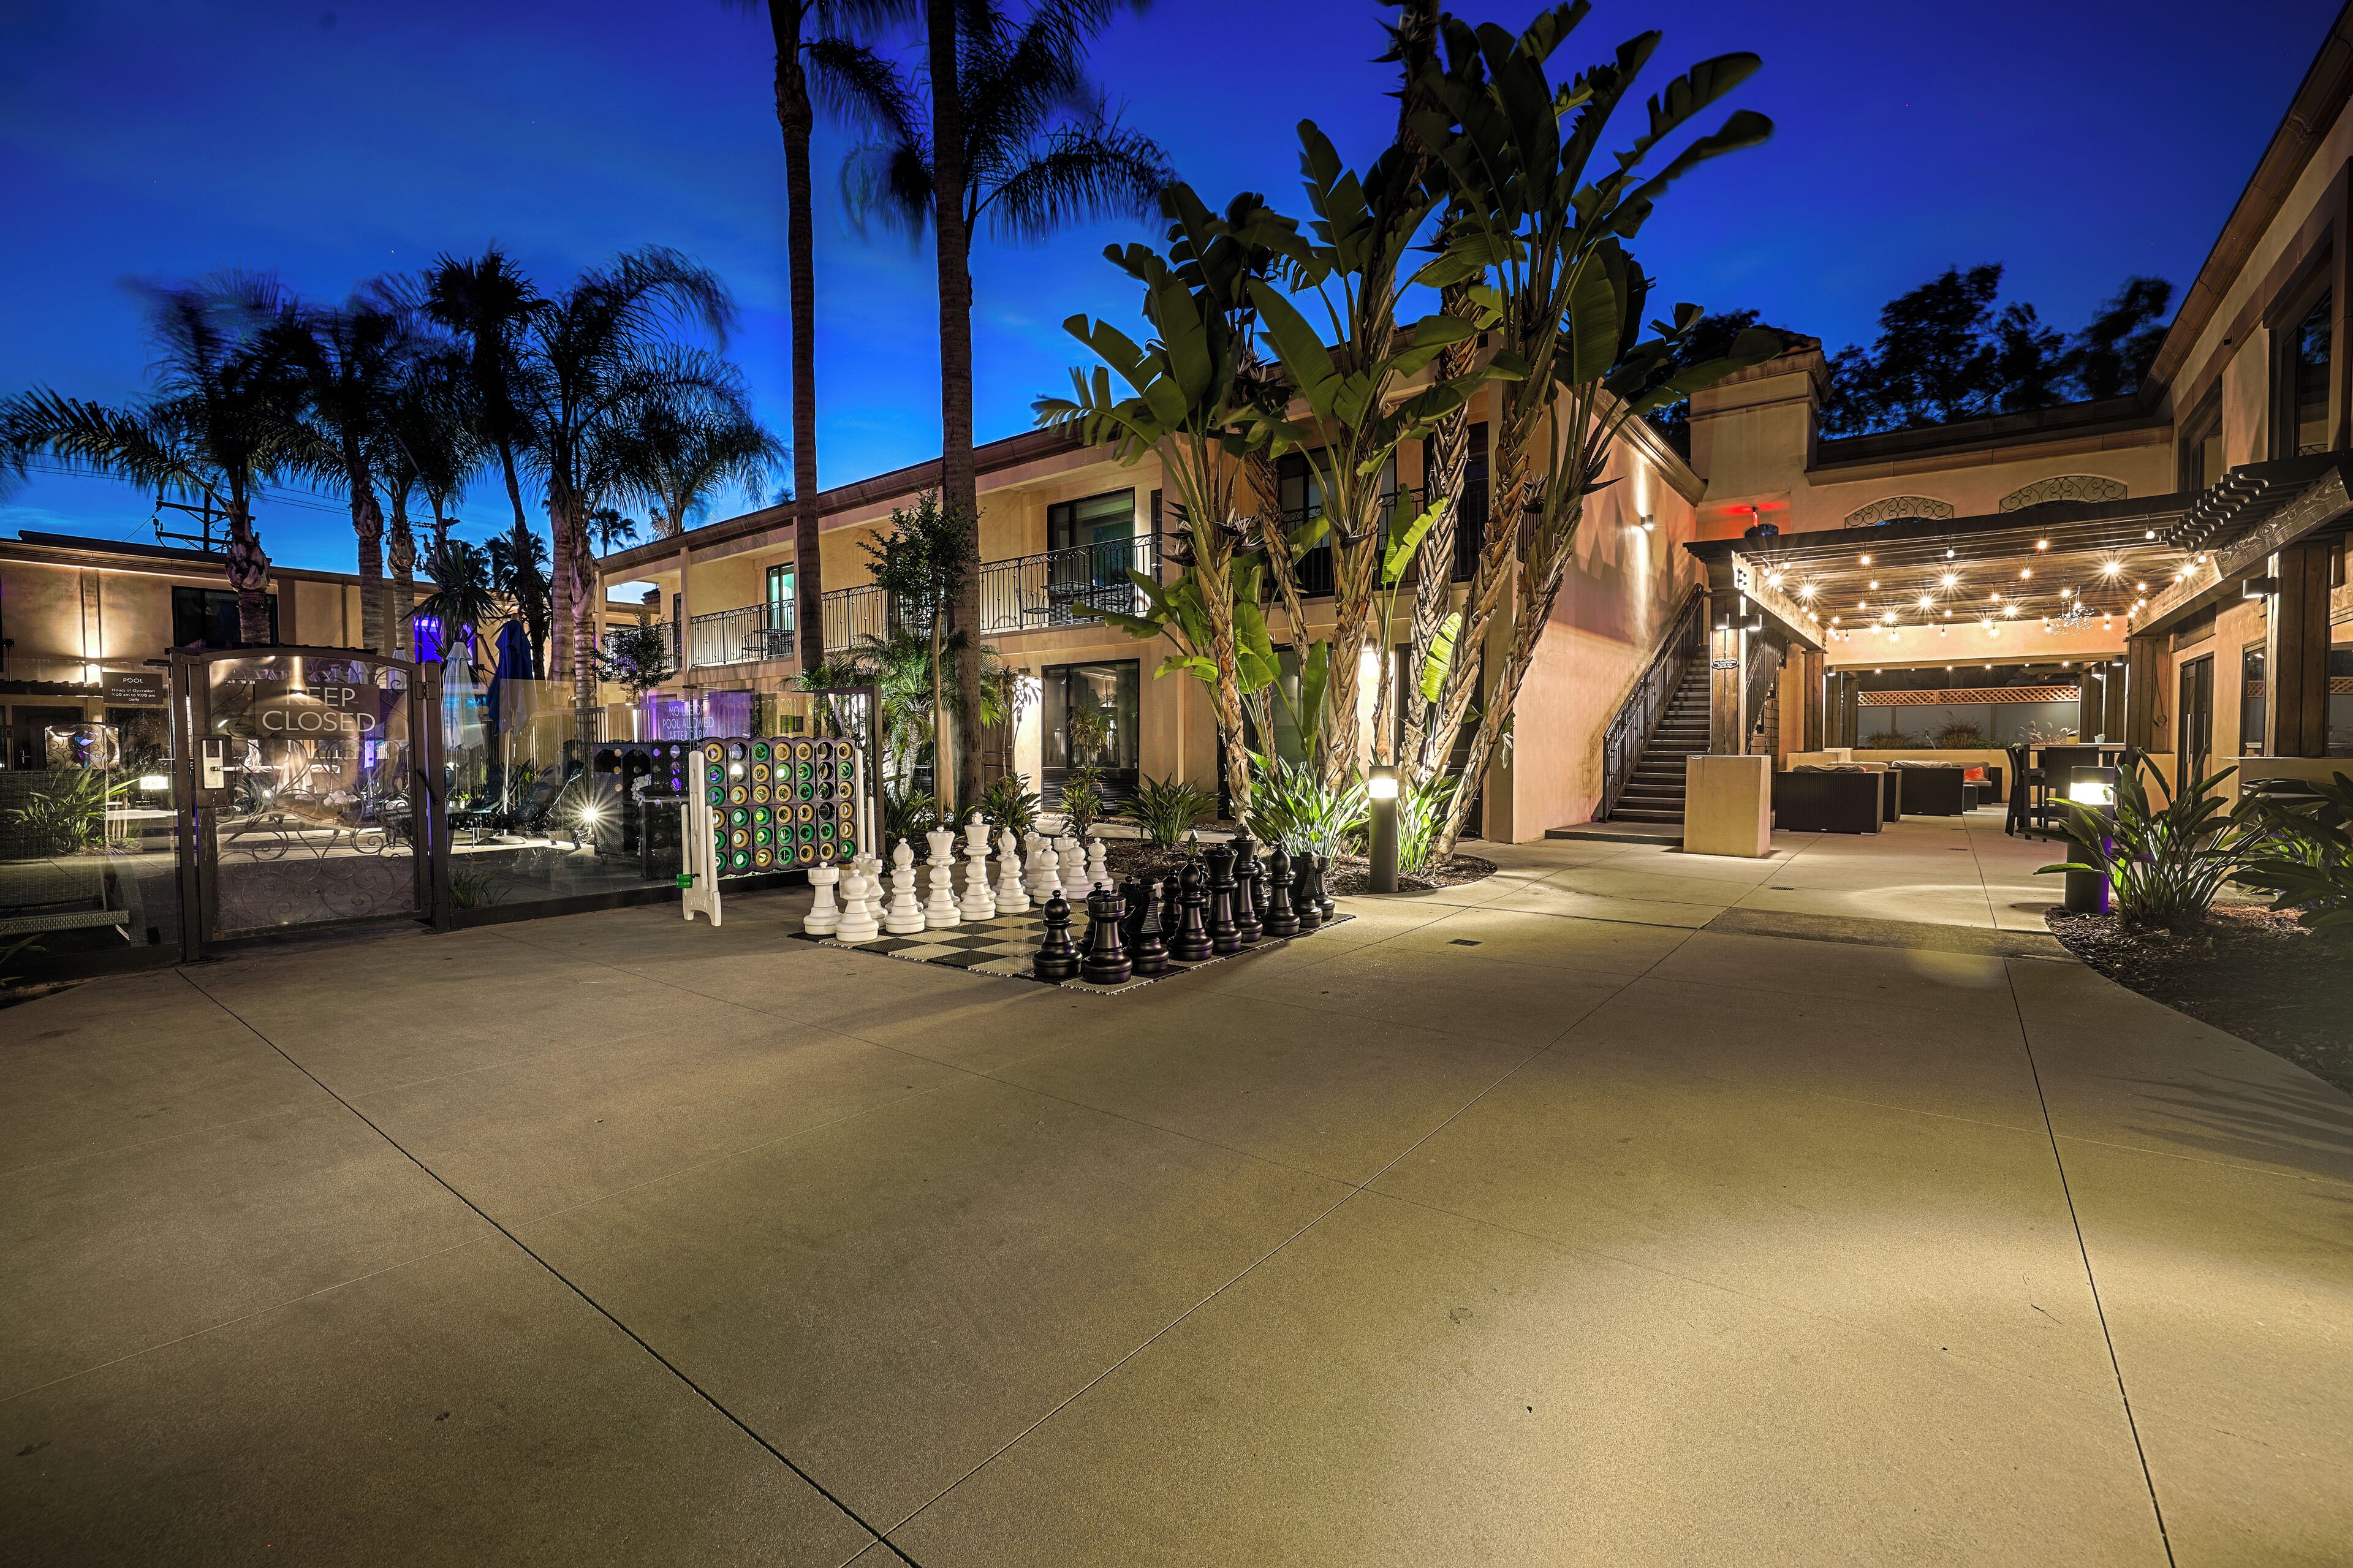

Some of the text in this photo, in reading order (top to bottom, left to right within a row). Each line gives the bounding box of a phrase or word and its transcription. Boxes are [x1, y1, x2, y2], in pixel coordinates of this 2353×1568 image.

[286, 686, 355, 706] KEEP
[669, 706, 680, 717] NO
[262, 710, 376, 732] CLOSED
[663, 716, 714, 729] POOL ALLOWED
[669, 730, 688, 741] AFTER
